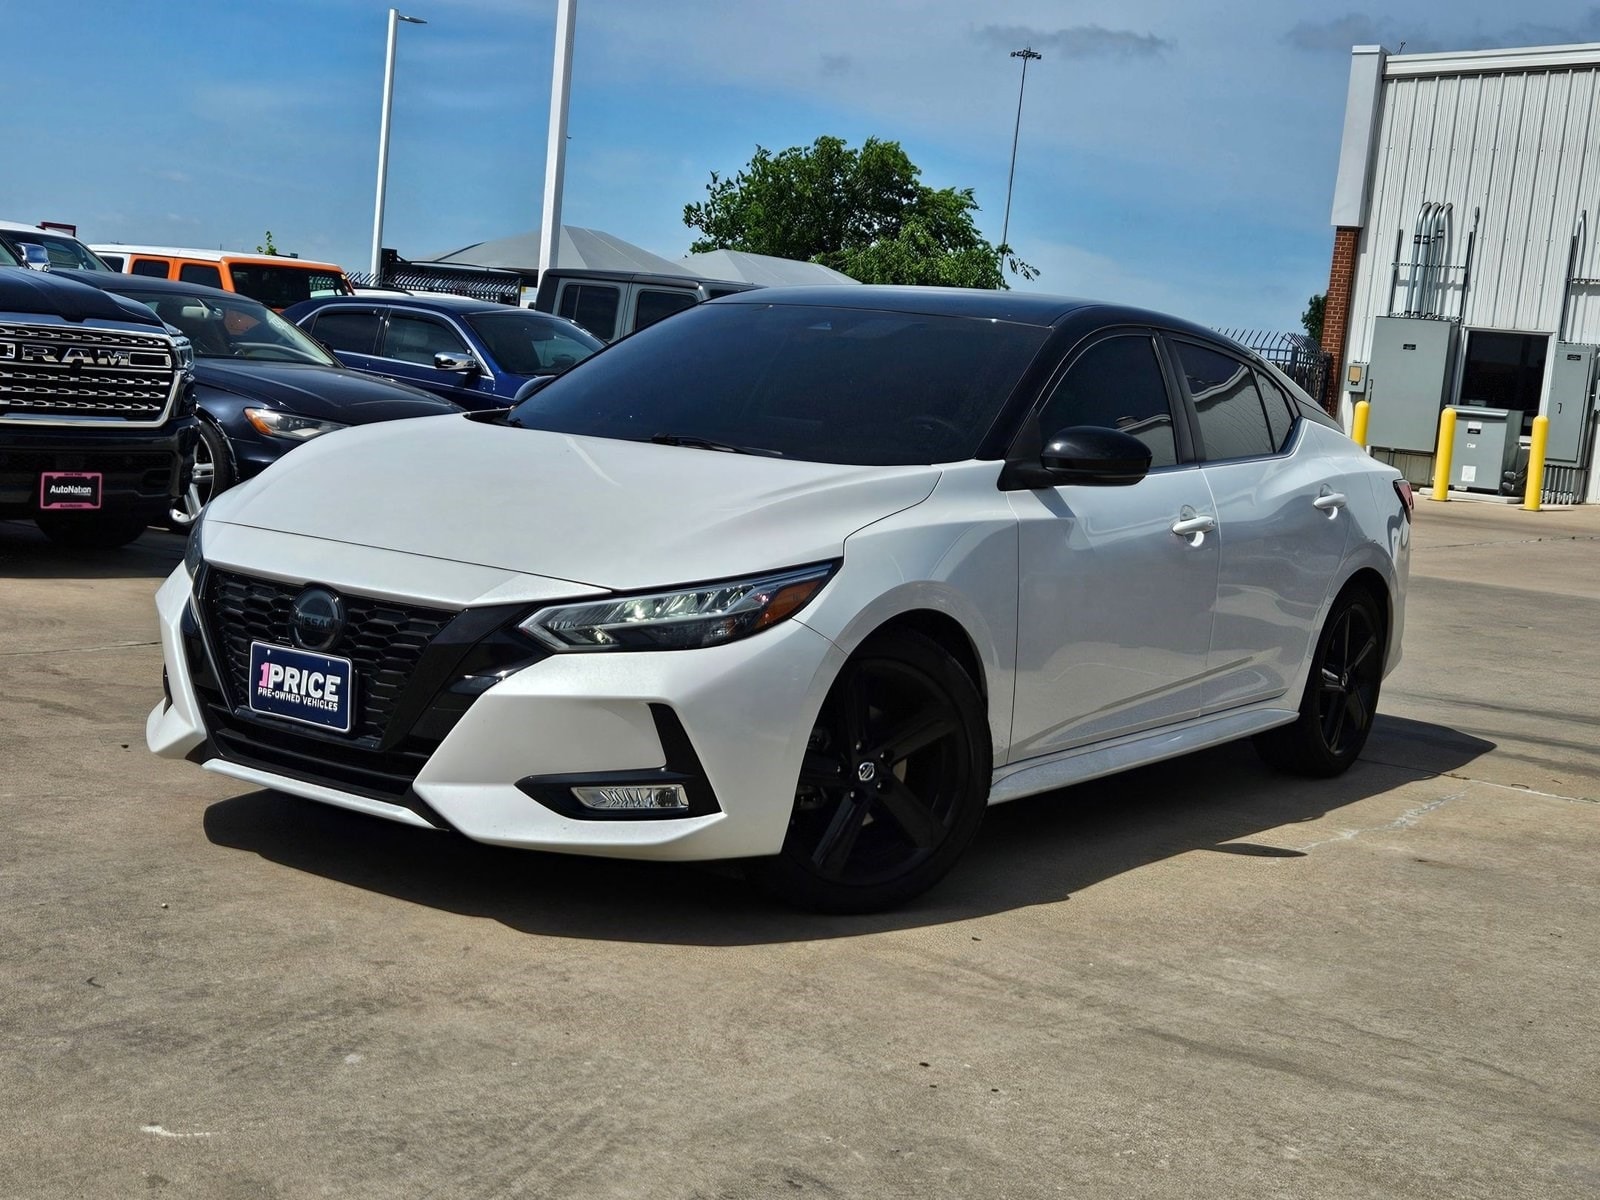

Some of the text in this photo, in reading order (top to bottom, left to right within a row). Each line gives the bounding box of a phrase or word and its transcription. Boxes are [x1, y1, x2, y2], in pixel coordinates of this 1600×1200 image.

[22, 344, 129, 366] RAM
[50, 485, 92, 494] AutoNation
[257, 687, 338, 712] PRE-OWNED VEHICLES
